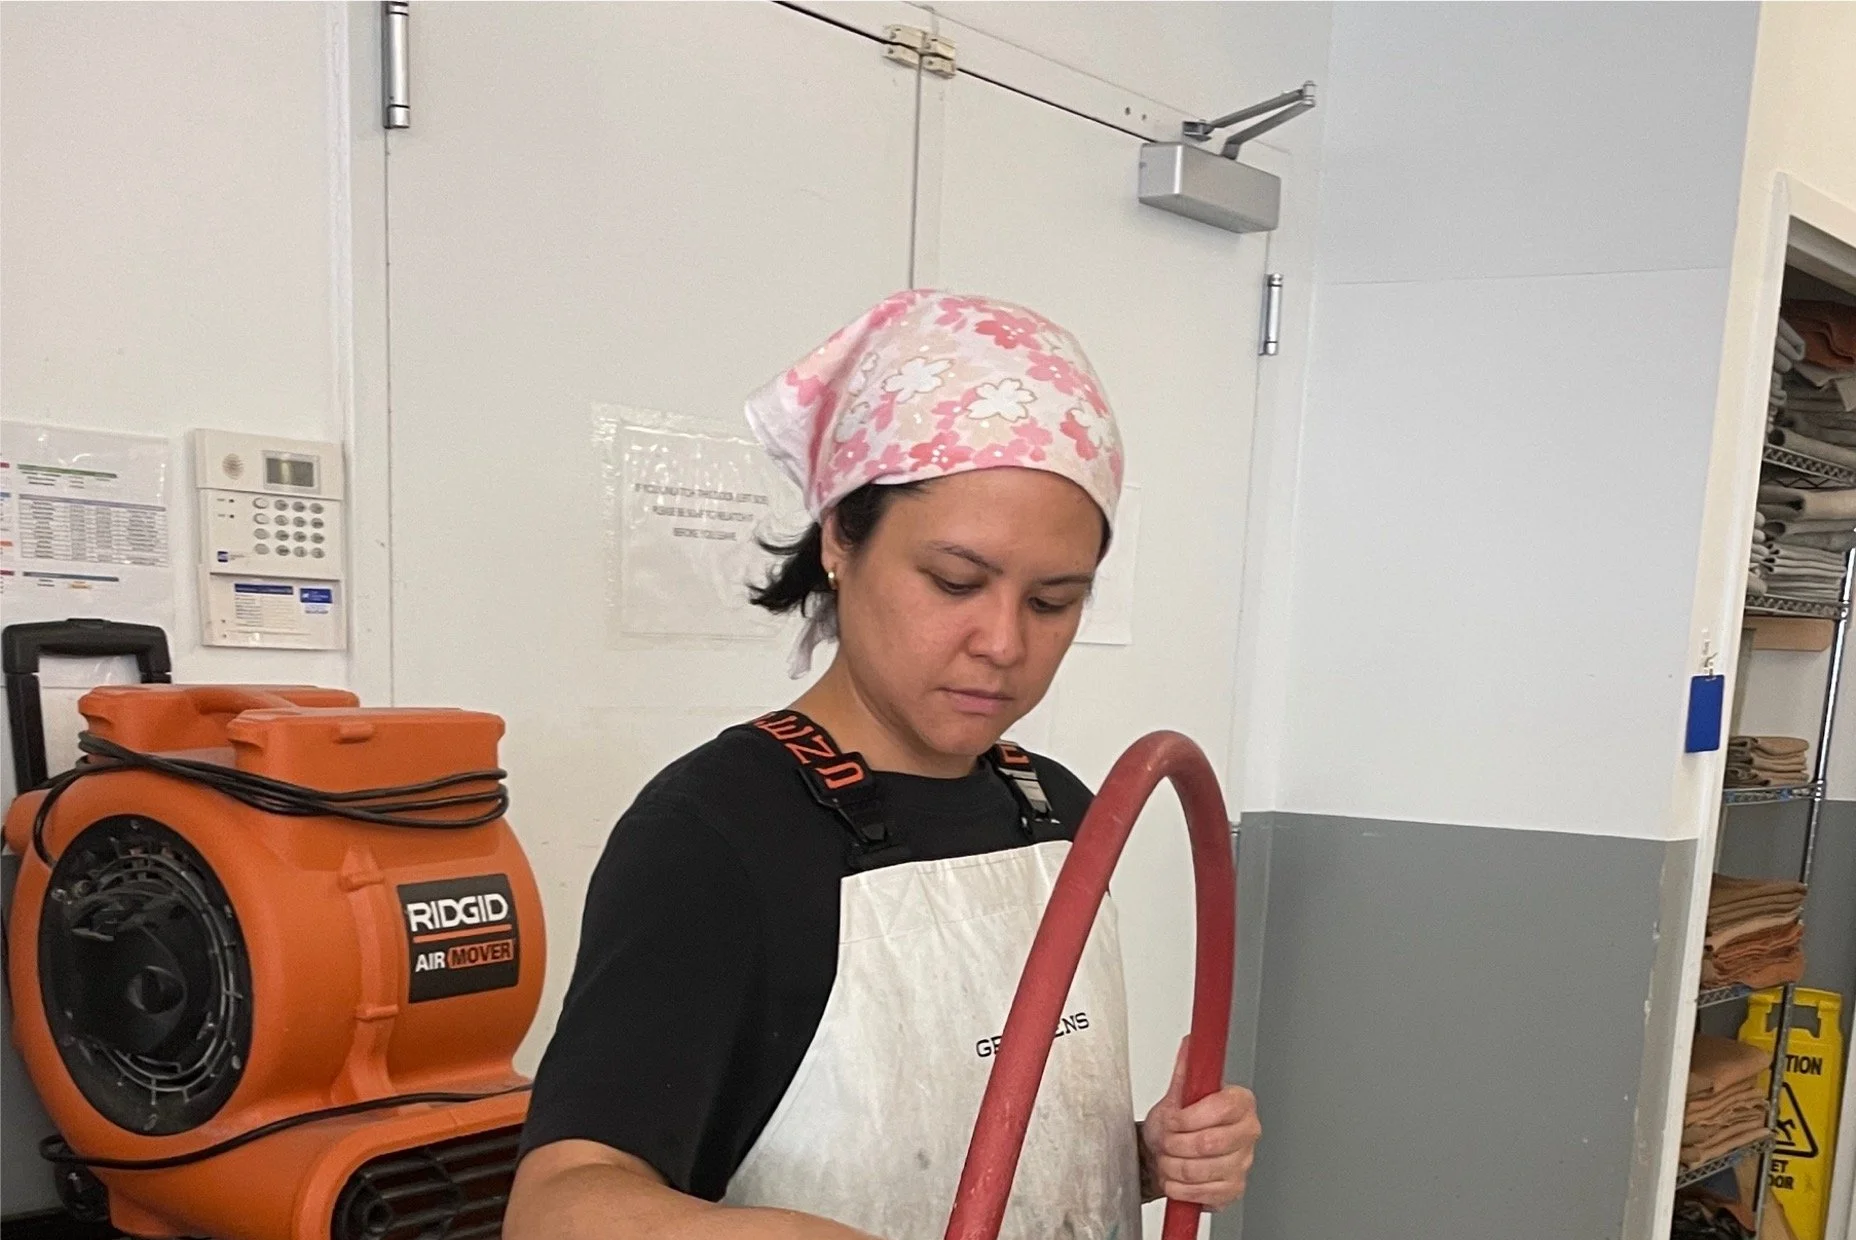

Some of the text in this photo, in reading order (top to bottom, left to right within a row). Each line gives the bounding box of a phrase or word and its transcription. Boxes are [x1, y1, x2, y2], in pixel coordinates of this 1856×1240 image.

[406, 893, 509, 932] RIDGID
[415, 942, 511, 972] AIR MOVER
[1785, 1054, 1822, 1076] TION
[1771, 1159, 1789, 1173] ET
[1767, 1174, 1794, 1190] OOR
